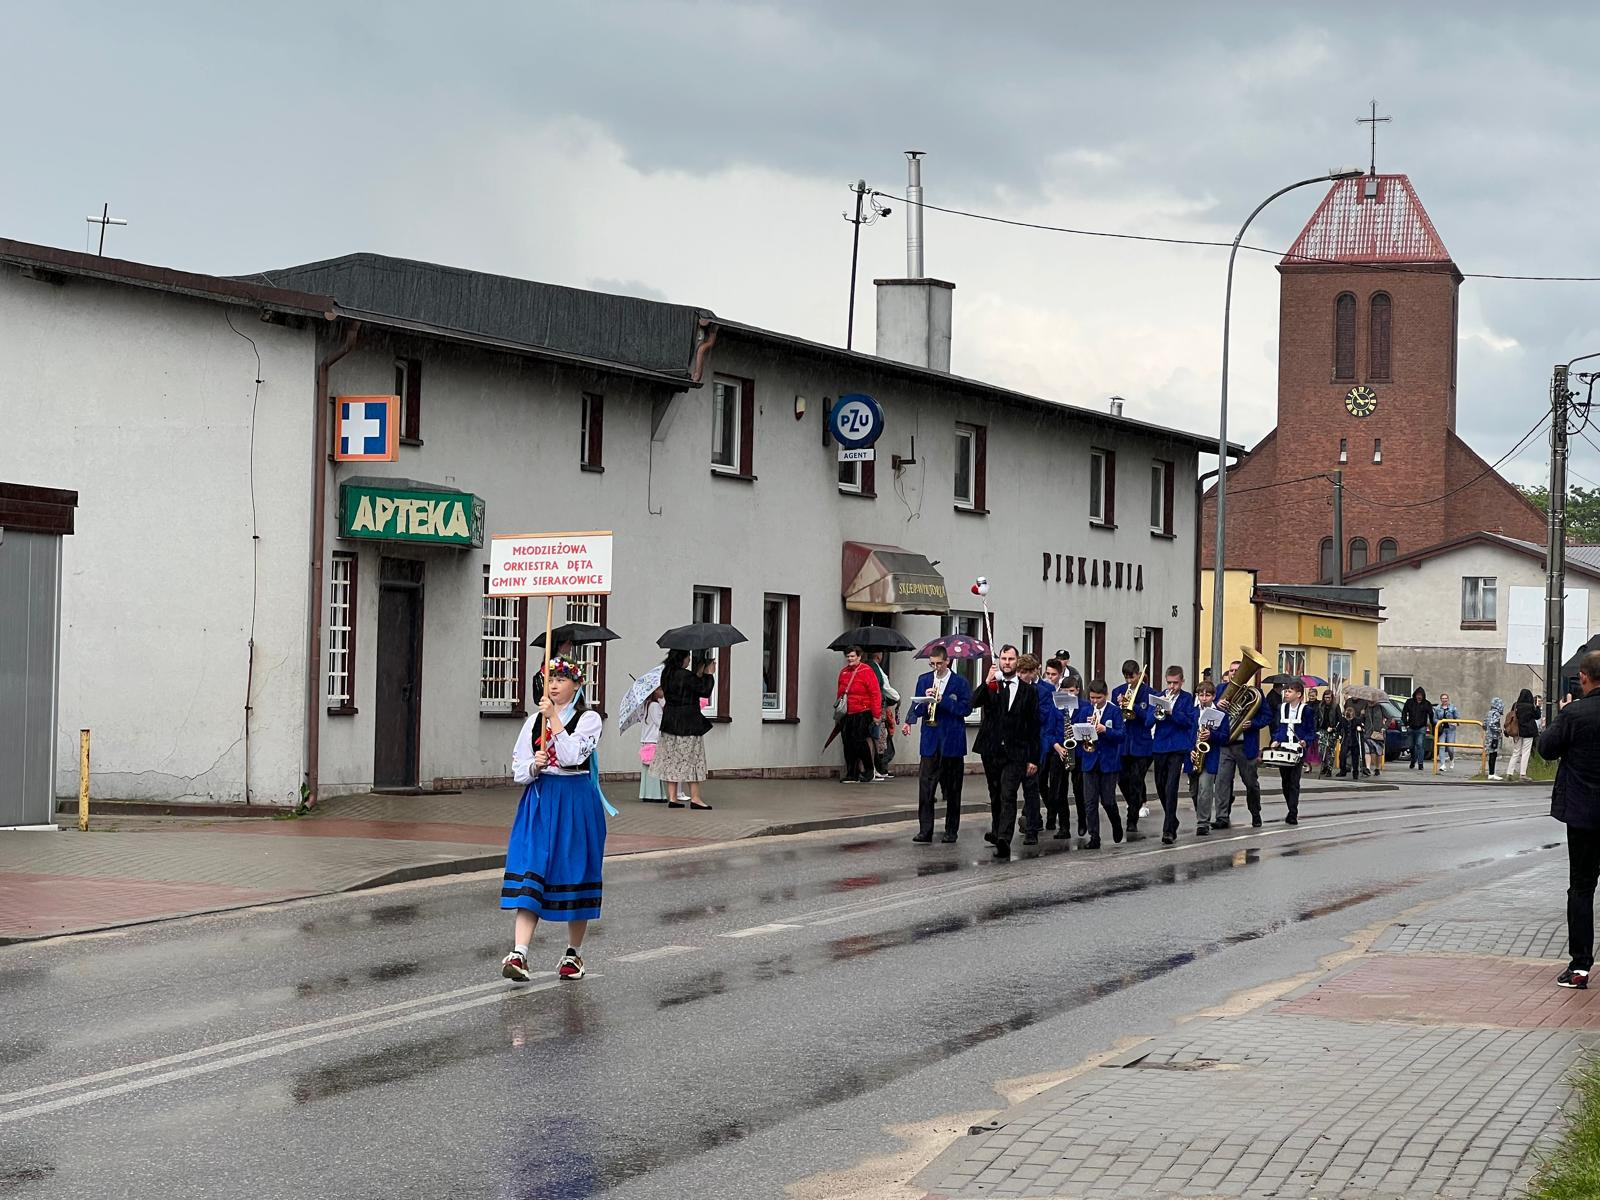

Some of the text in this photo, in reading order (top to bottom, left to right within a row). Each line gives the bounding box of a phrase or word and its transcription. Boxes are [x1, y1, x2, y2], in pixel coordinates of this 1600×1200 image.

[841, 409, 869, 432] PZU
[351, 495, 470, 538] APTEKA
[512, 542, 587, 556] MŁODZIEŻOWA
[503, 560, 593, 572] ORKIESTRA DĘTA
[1042, 552, 1144, 592] PIEKARNIA
[492, 575, 603, 587] GMINY SIERAKOWICE
